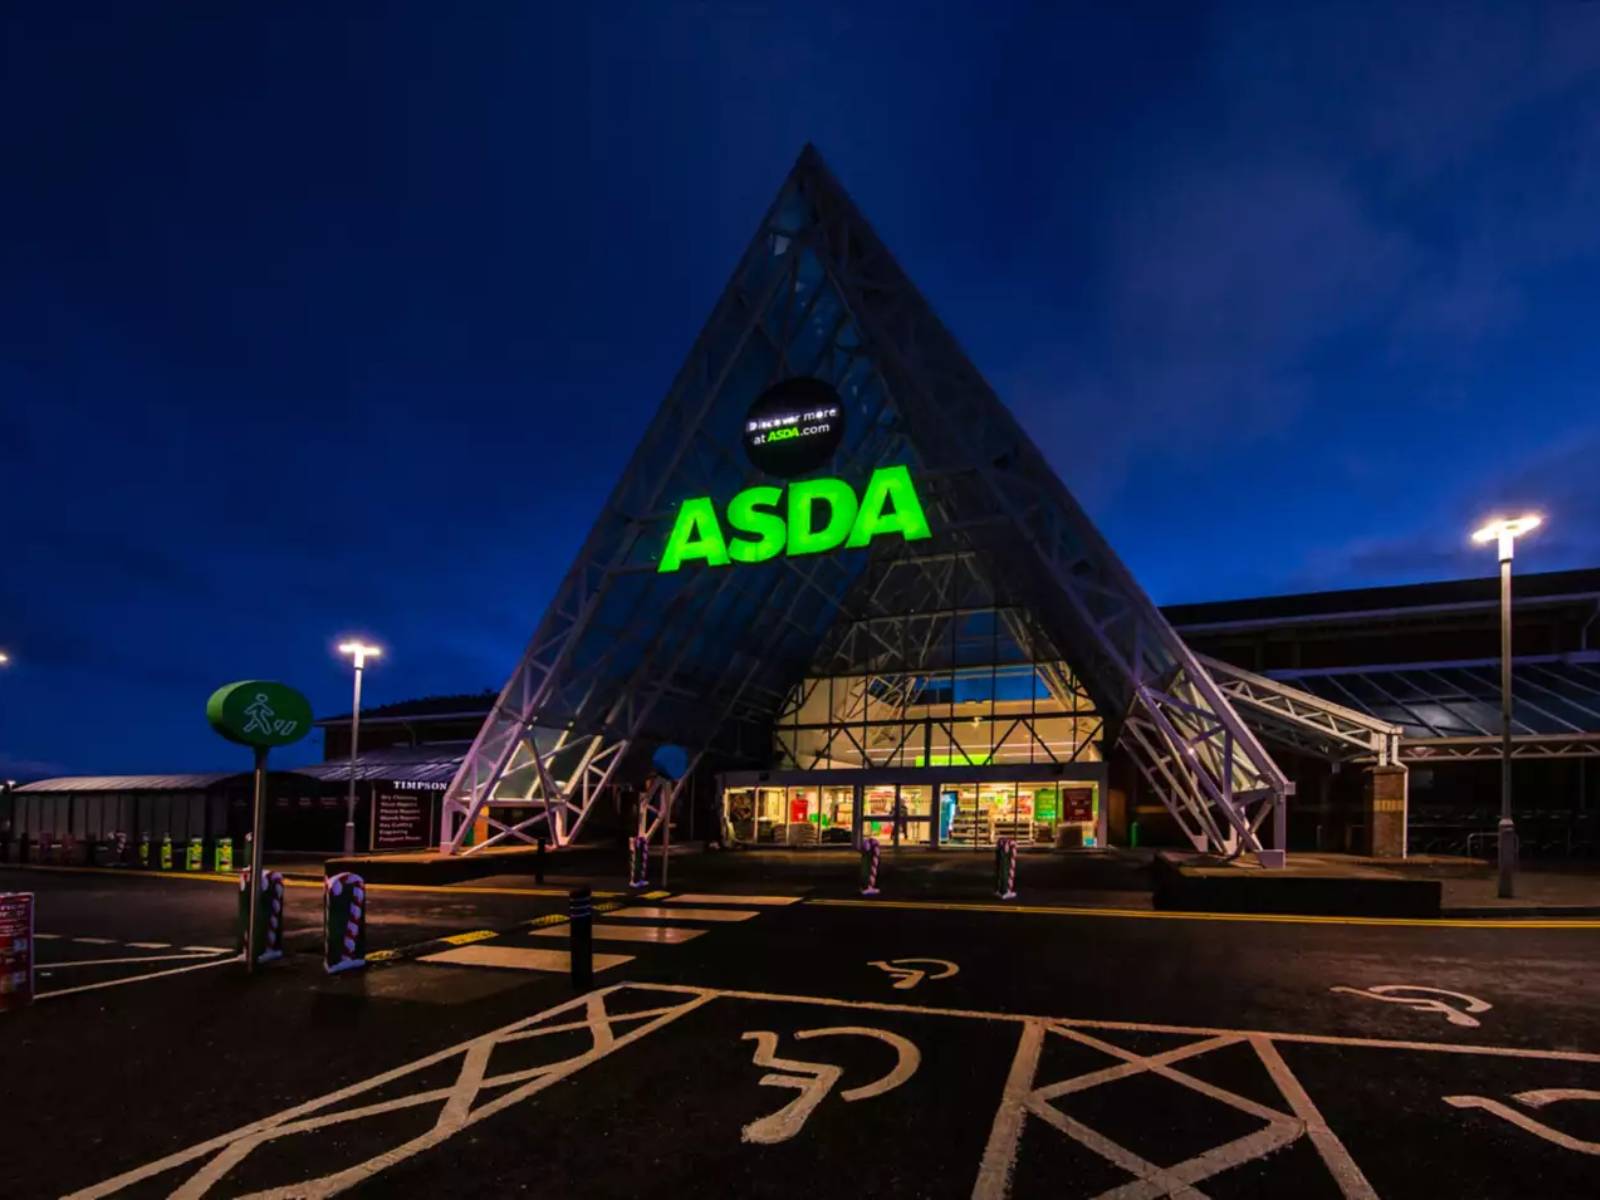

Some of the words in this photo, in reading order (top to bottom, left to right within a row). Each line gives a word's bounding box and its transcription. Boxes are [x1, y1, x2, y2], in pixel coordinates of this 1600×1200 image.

[803, 408, 838, 421] more
[753, 434, 766, 445] at
[767, 423, 831, 442] ASDA.com
[657, 465, 932, 573] ASDA
[393, 780, 448, 791] TIMPSON
